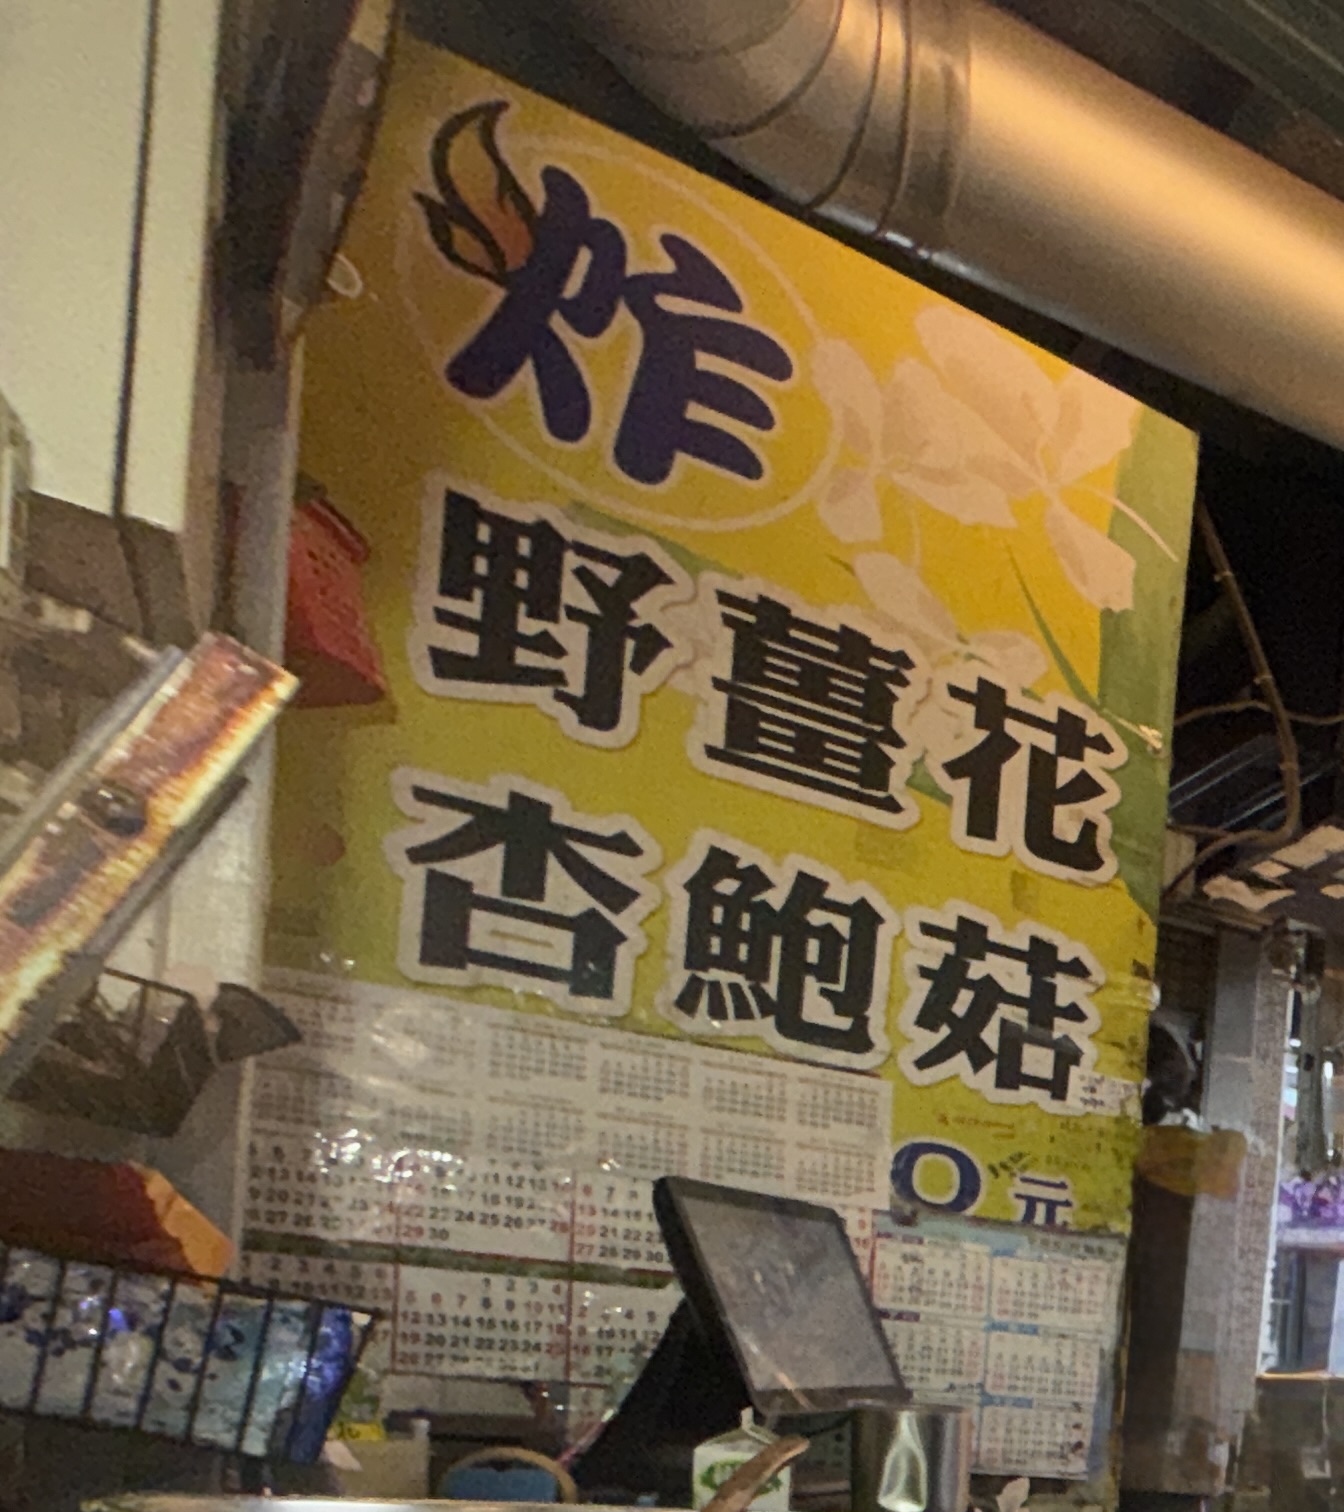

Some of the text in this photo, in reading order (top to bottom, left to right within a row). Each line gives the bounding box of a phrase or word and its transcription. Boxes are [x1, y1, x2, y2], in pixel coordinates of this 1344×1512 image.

[415, 101, 794, 487] 炸
[431, 488, 1116, 875] 野薑花
[404, 784, 1094, 1102] 杏鮑菇
[455, 1209, 475, 1223] 24
